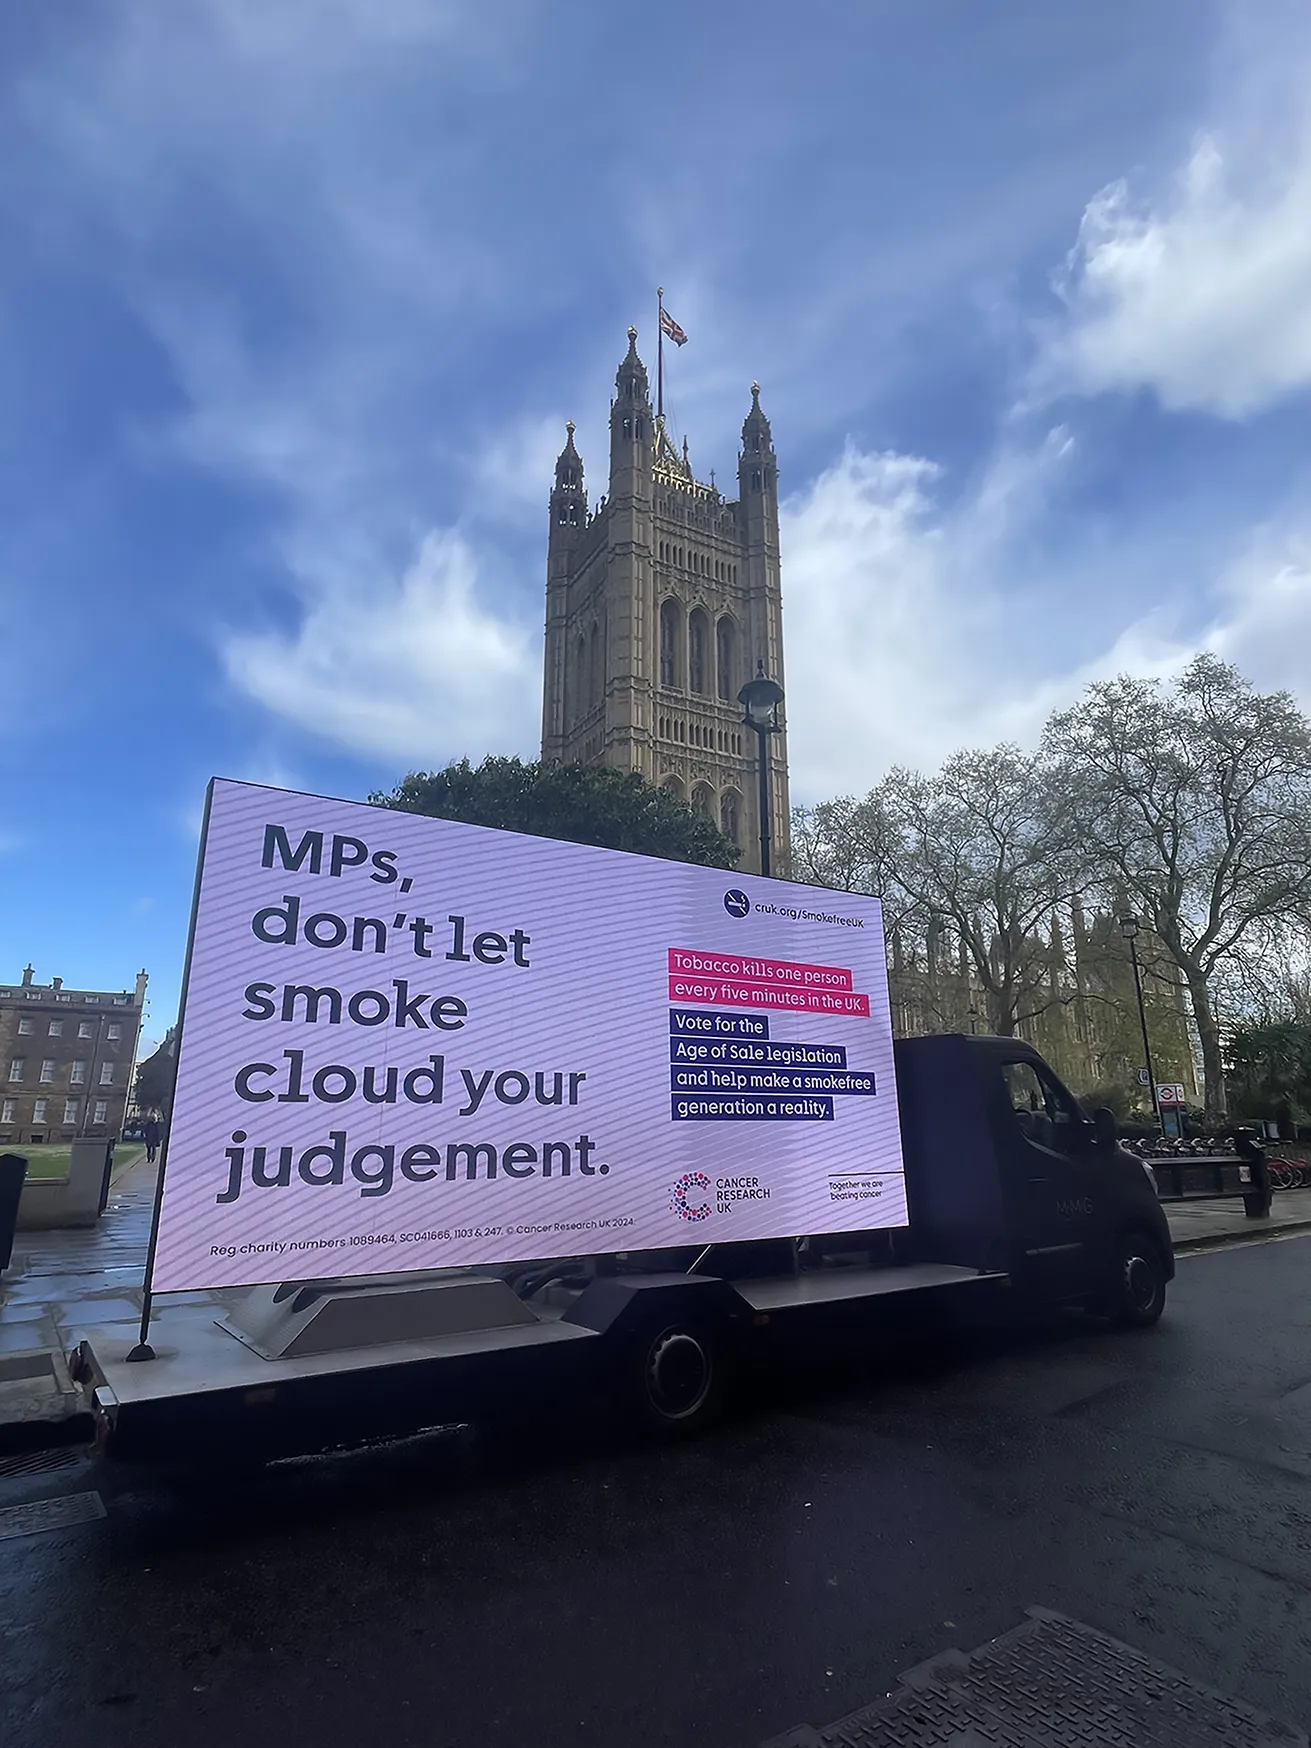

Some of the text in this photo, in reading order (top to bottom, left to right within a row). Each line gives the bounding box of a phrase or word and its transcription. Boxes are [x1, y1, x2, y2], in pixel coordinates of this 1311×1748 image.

[261, 824, 413, 893] MPs,
[755, 904, 865, 928] cruk.org/SmokefreeUK
[251, 896, 531, 968] don't let
[674, 954, 846, 986] Tobacco kills one person
[241, 979, 468, 1030] smoke
[675, 983, 865, 1011] every five minutes in the UK.
[675, 1014, 763, 1034] Vote for the
[676, 1042, 841, 1064] Age of Sale legislation
[234, 1050, 586, 1116] cloud your
[677, 1070, 871, 1089] and help make a smokefree
[677, 1099, 830, 1118] generation a reality.
[216, 1130, 610, 1203] judgement.
[716, 1177, 759, 1189] CANCER
[716, 1189, 771, 1201] RESEARCH
[830, 1190, 882, 1201] beating cancer
[716, 1203, 732, 1213] UK
[210, 1245, 236, 1258] Reg
[240, 1242, 286, 1254] charity
[290, 1239, 346, 1250] numbers
[349, 1233, 397, 1246] 1089464,
[400, 1230, 452, 1243] SC041666,
[454, 1229, 473, 1239] 1103
[474, 1228, 482, 1237] &
[484, 1227, 503, 1236] 247.
[516, 1224, 552, 1234] Cancer
[554, 1221, 597, 1231] Research
[598, 1219, 611, 1228] UK
